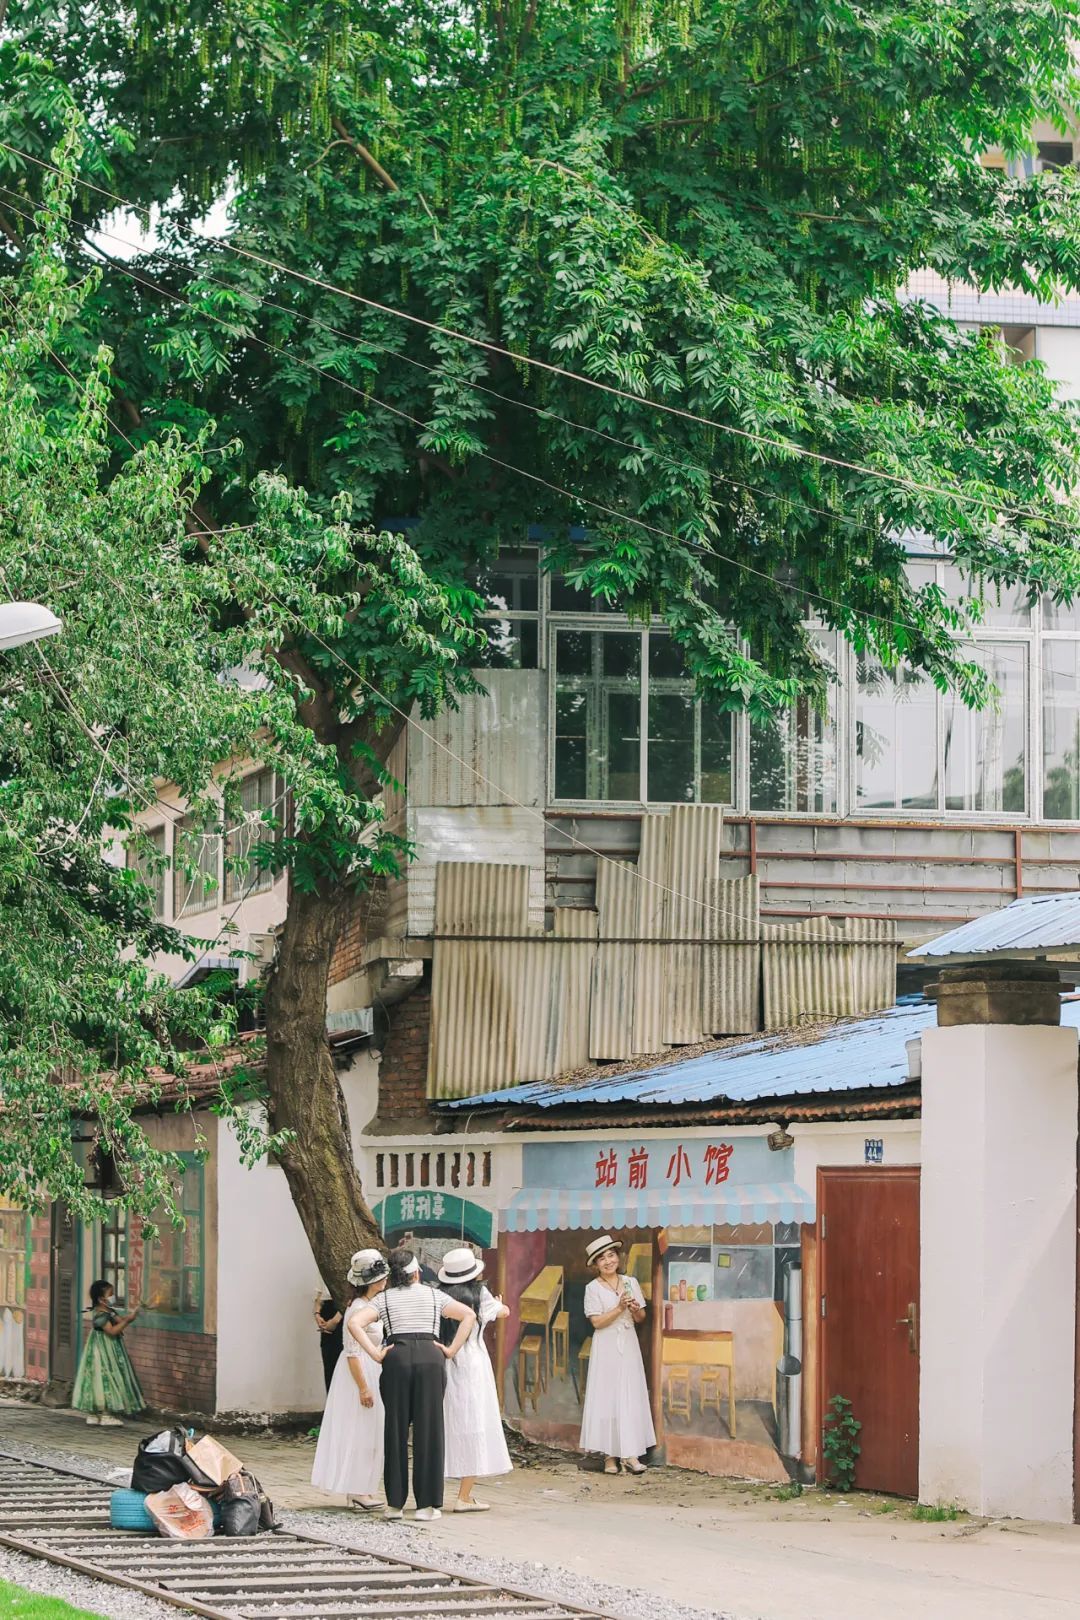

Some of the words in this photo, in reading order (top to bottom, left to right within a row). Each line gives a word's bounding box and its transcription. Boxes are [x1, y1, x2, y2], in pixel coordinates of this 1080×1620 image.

[595, 1143, 734, 1189] 站前小馆
[400, 1193, 445, 1221] 报刊亭
